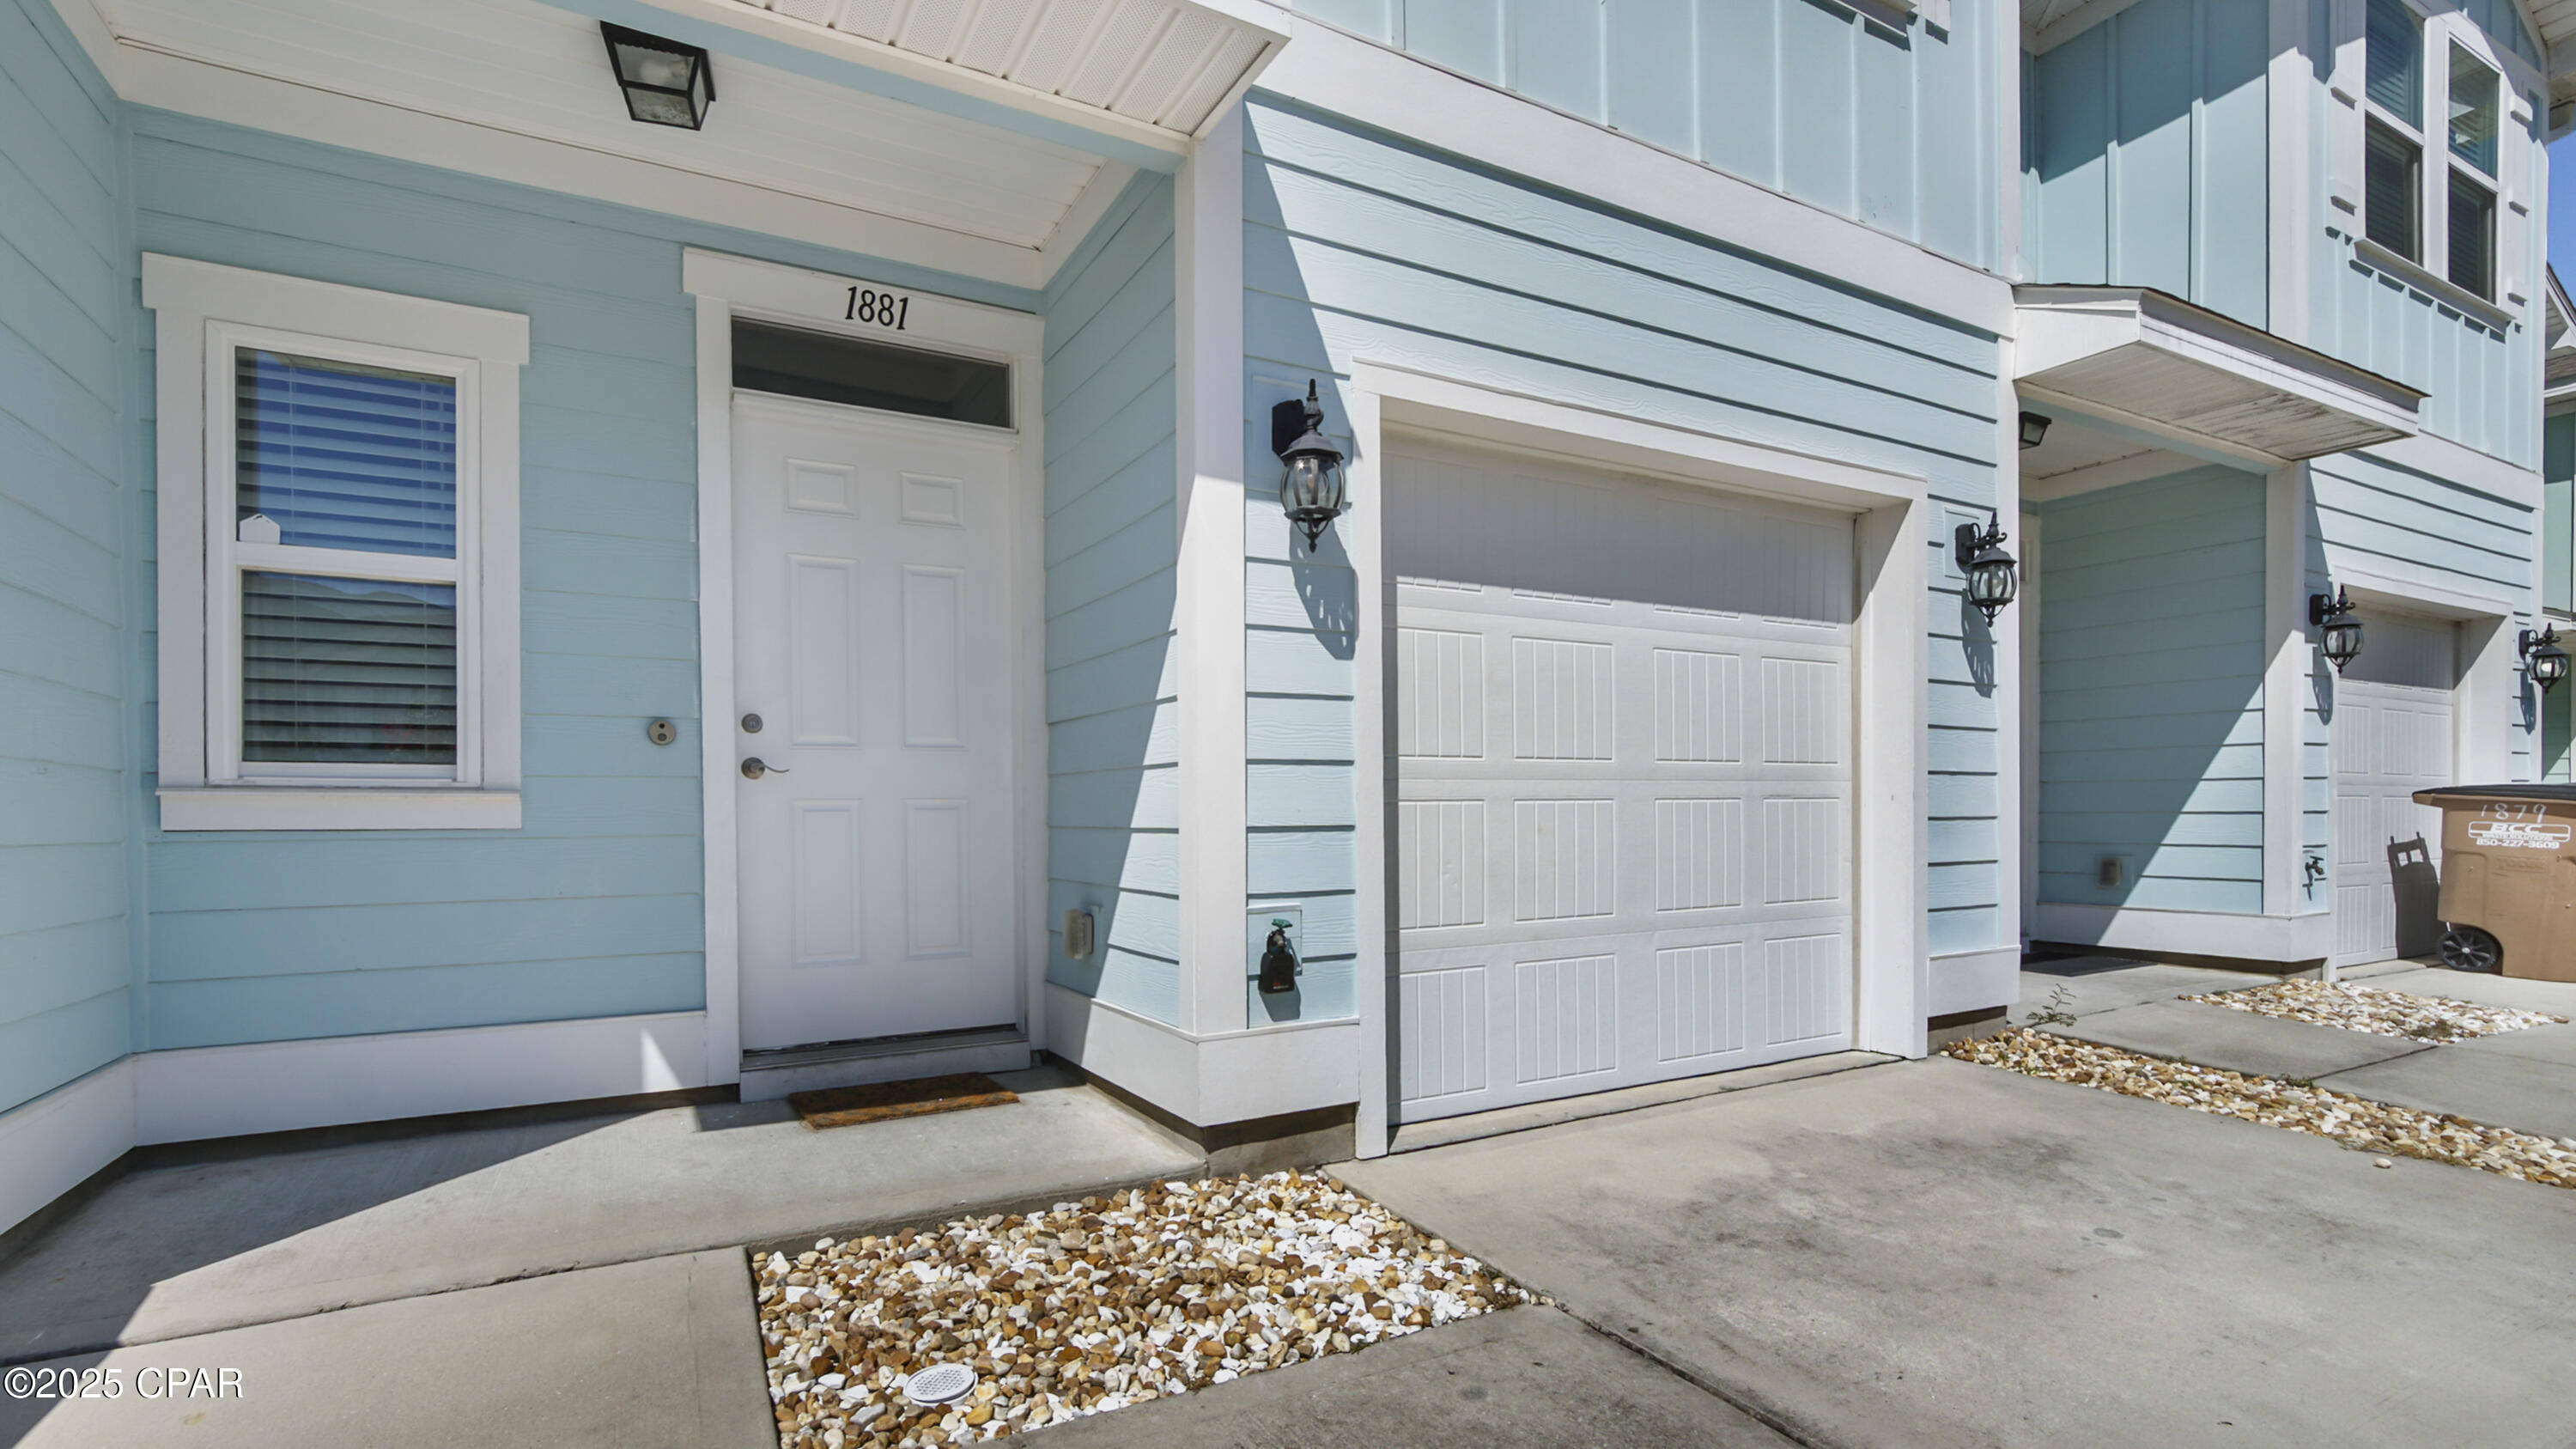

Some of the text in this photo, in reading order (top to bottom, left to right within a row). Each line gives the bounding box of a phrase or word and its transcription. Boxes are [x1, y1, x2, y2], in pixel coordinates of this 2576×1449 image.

[845, 286, 908, 330] 1881
[2481, 803, 2546, 824] 1879
[2490, 823, 2542, 834] BCC
